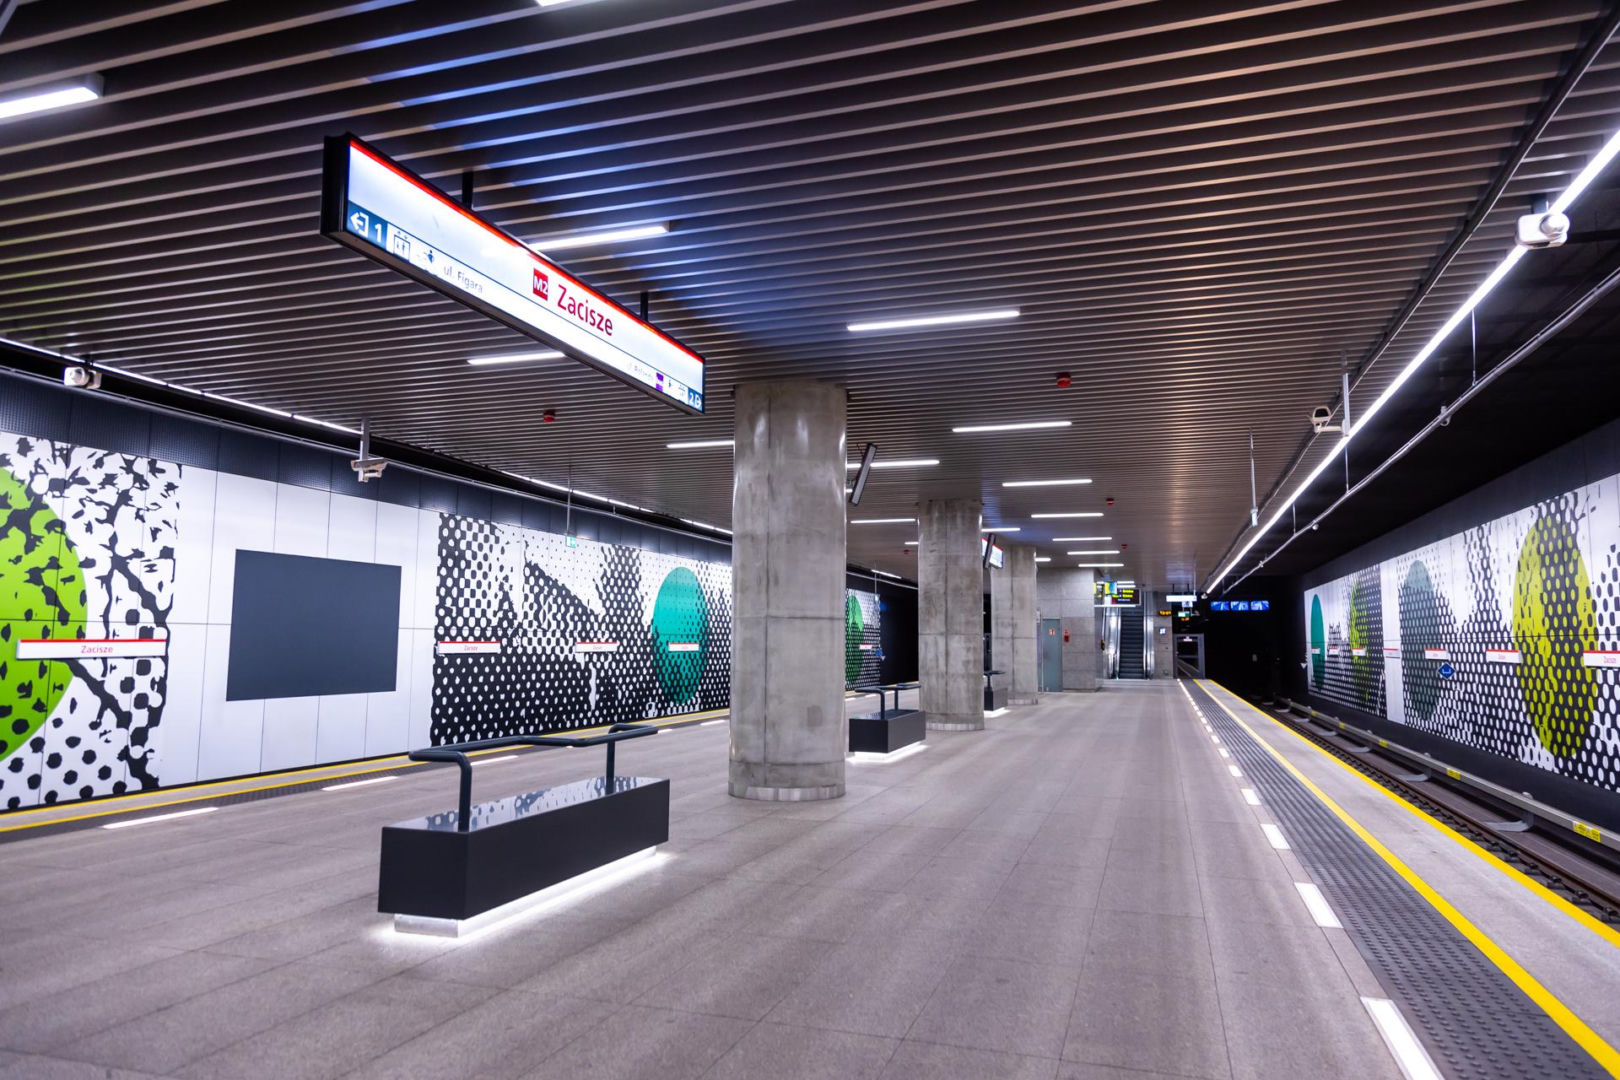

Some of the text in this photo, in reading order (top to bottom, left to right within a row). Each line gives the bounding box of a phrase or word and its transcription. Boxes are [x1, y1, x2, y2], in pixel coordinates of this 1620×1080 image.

[374, 223, 382, 243] 1
[457, 271, 483, 294] Figara
[533, 274, 613, 336] M2 Zacisze
[81, 645, 113, 654] Zacisze
